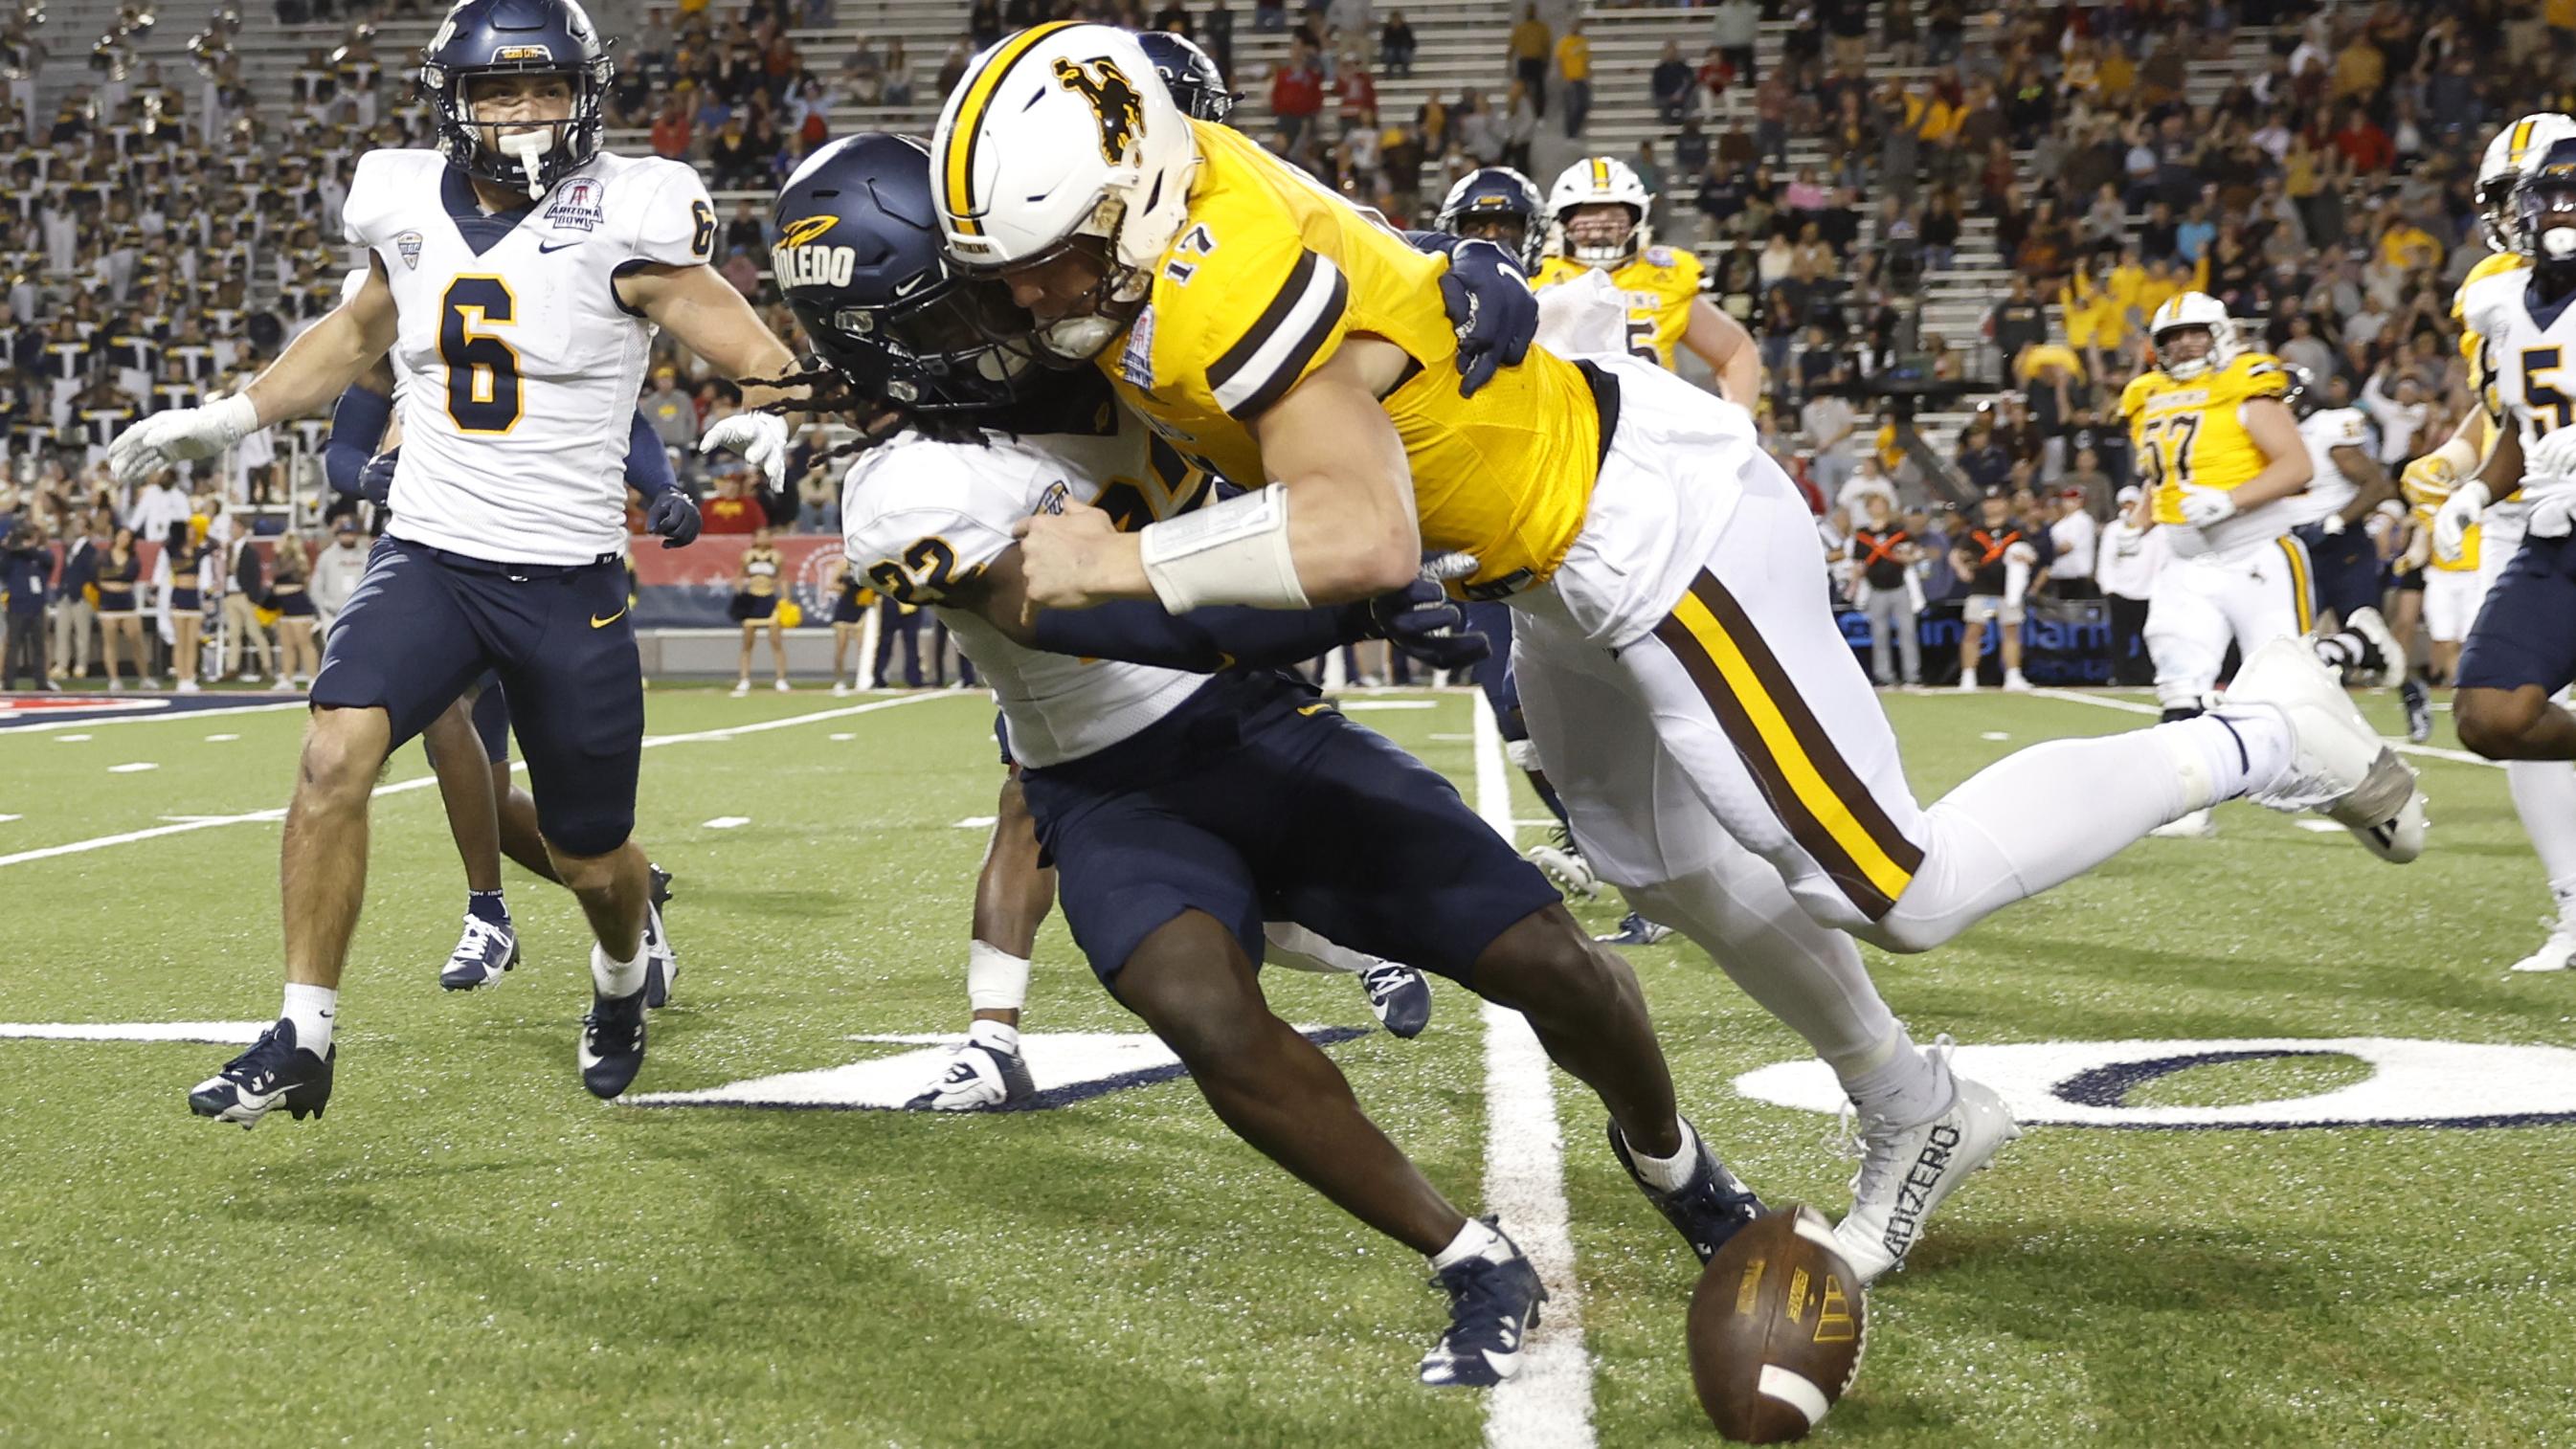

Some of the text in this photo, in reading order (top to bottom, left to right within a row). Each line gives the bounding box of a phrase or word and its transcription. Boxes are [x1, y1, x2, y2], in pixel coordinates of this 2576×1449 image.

[549, 206, 599, 218] ARIZONA
[557, 215, 590, 228] BOWL
[690, 199, 715, 257] 6
[772, 244, 857, 290] TOLEDO
[1165, 222, 1217, 285] 17
[436, 273, 525, 435] 6
[2143, 412, 2203, 486] 57
[1883, 1125, 1960, 1258] ADIZERO
